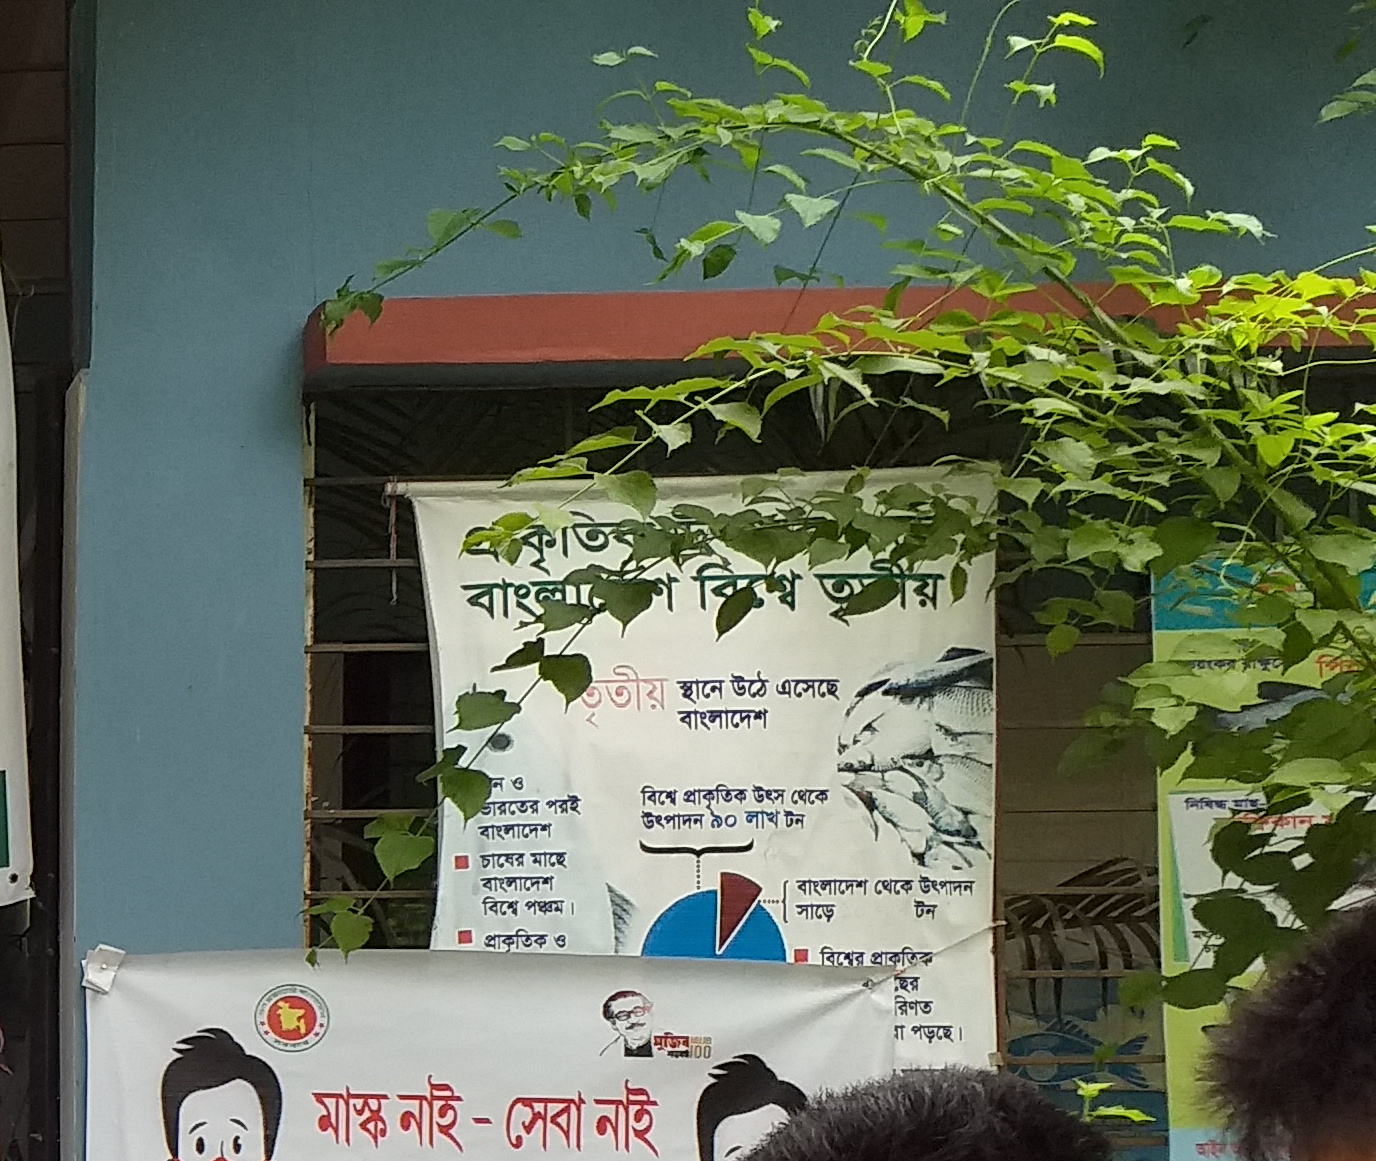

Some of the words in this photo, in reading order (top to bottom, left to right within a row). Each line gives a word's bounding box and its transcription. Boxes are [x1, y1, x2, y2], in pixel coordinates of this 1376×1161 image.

[676, 678, 725, 704] স্থানে
[730, 670, 769, 698] উঠে
[775, 678, 840, 701] এসেছে
[678, 708, 768, 730] বাংলাদেশ
[546, 794, 582, 815] পরই
[791, 788, 829, 805] থেকে
[745, 810, 780, 829] লাখ
[784, 810, 805, 829] টন
[478, 823, 552, 841] বাংলাদেশ
[480, 852, 525, 869] চাষের
[531, 852, 567, 869] মাছে
[481, 875, 554, 893] বাংলাদেশ
[796, 879, 869, 896] বাংলাদেশ
[875, 878, 914, 895] থেকে
[918, 875, 975, 896] উৎপাদন
[914, 902, 937, 920] টন
[311, 1085, 390, 1148] মাস্ক
[397, 1074, 464, 1153] নাই
[505, 1090, 585, 1152] সেবা
[593, 1079, 660, 1159] নাই
